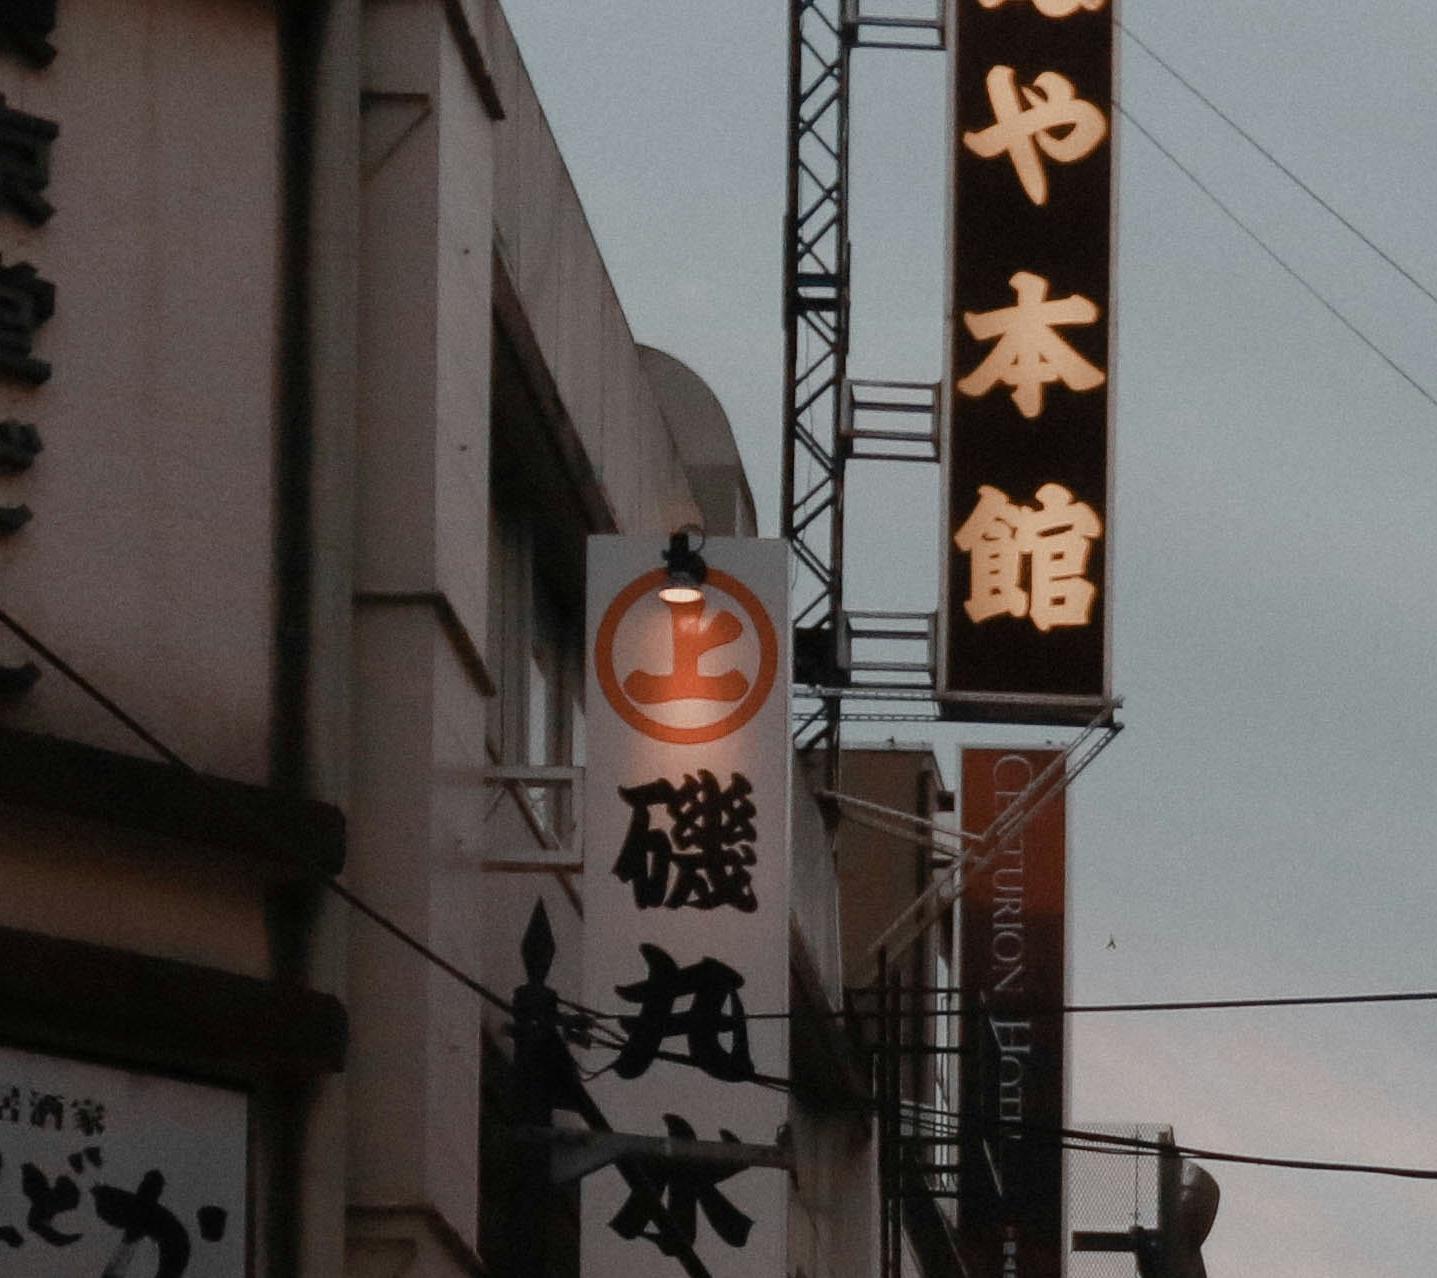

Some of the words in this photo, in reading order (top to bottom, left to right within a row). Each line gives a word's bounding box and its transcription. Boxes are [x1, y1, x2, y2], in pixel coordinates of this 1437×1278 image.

[954, 0, 1109, 633] や本館
[993, 754, 1034, 993] CETURION
